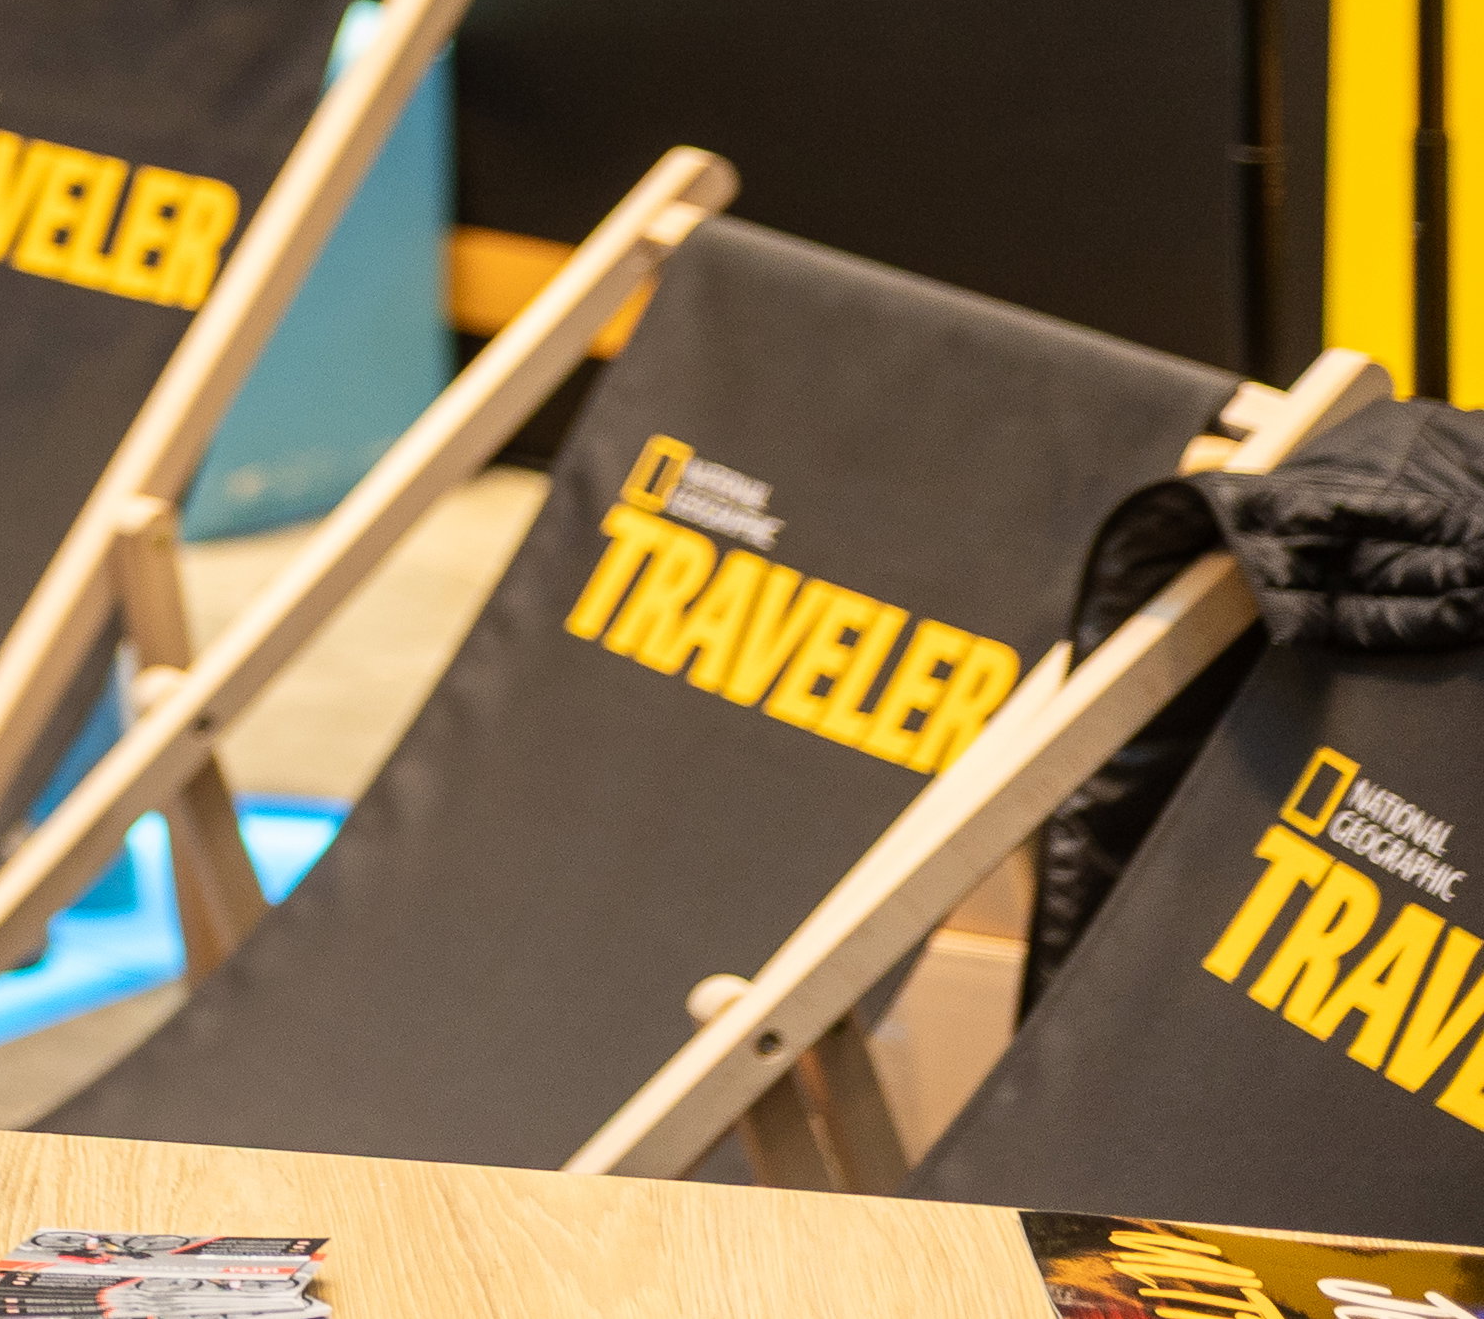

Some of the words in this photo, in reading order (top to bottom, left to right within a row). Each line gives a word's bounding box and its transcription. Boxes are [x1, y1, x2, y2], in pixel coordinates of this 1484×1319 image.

[564, 502, 1021, 776] TRAVELER
[1327, 810, 1469, 903] GEOGRAPHIC
[1346, 778, 1456, 858] NATIONAL
